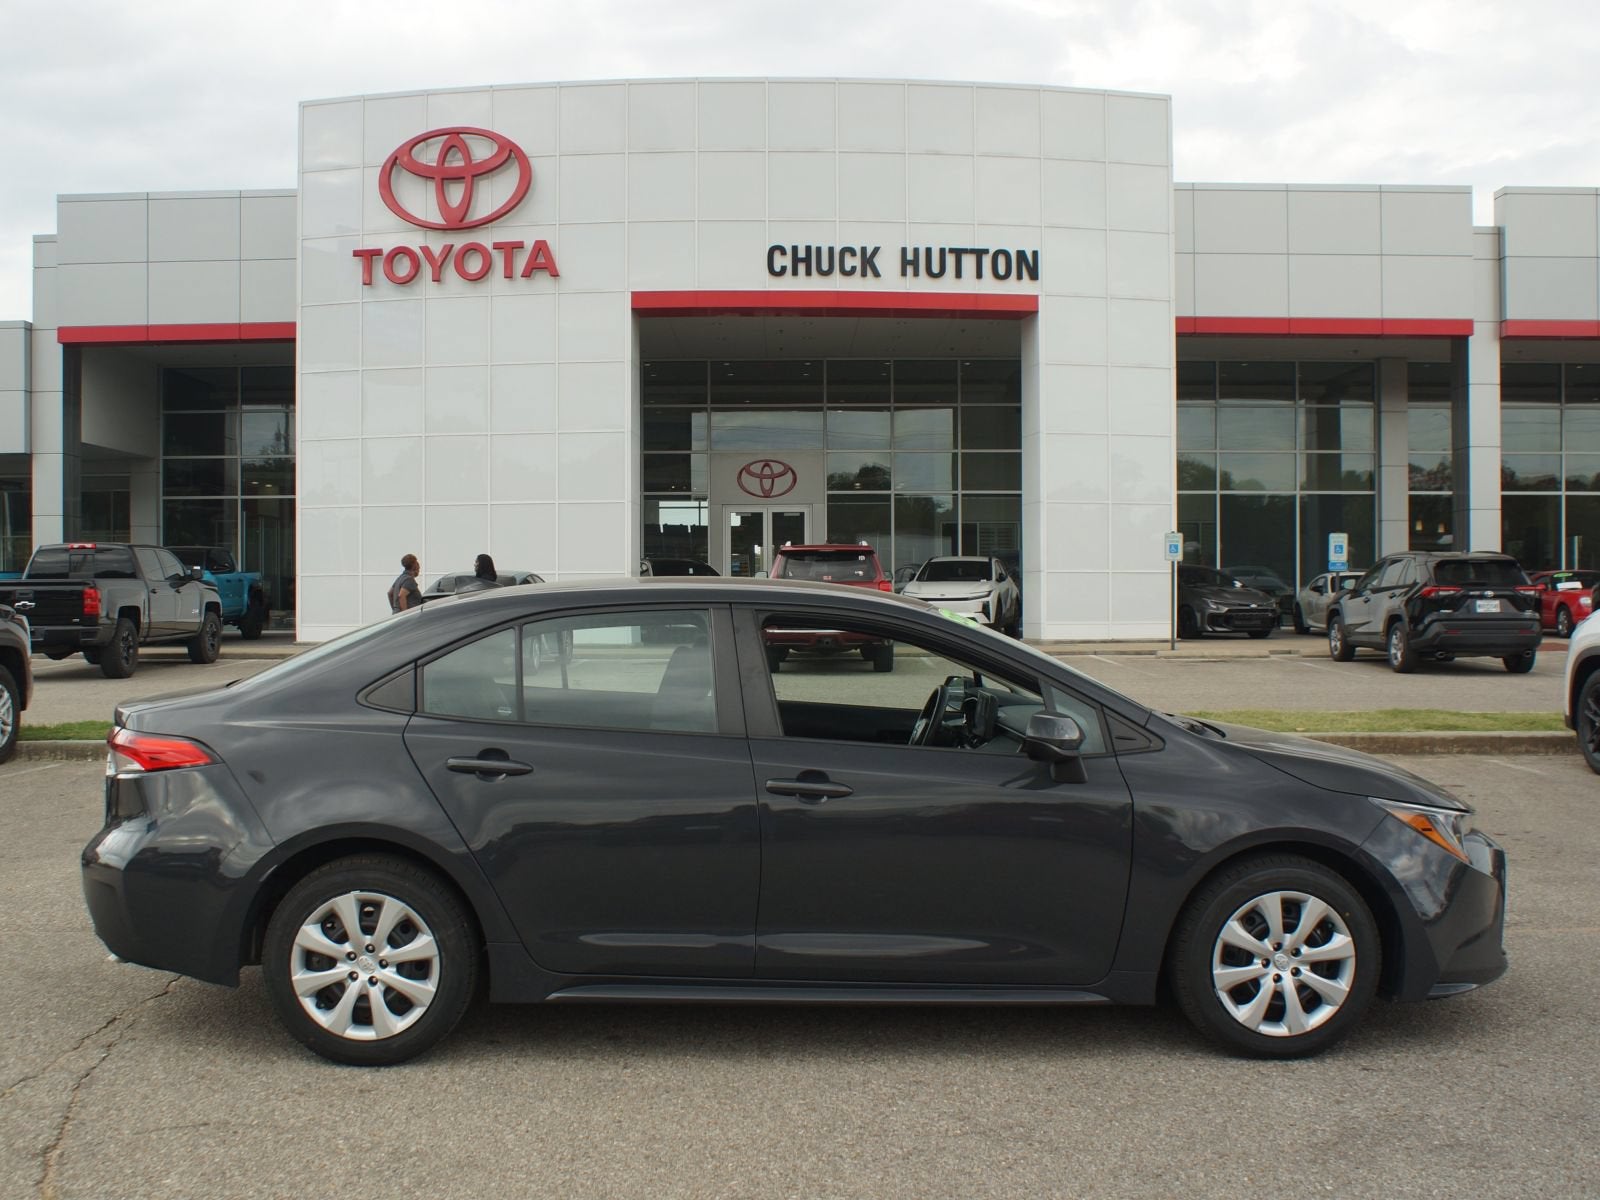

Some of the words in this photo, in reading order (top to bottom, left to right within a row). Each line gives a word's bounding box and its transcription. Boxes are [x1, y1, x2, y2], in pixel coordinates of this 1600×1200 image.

[352, 239, 560, 286] TOYOTA
[767, 244, 882, 277] CHUCK
[900, 246, 1040, 281] HUTTON
